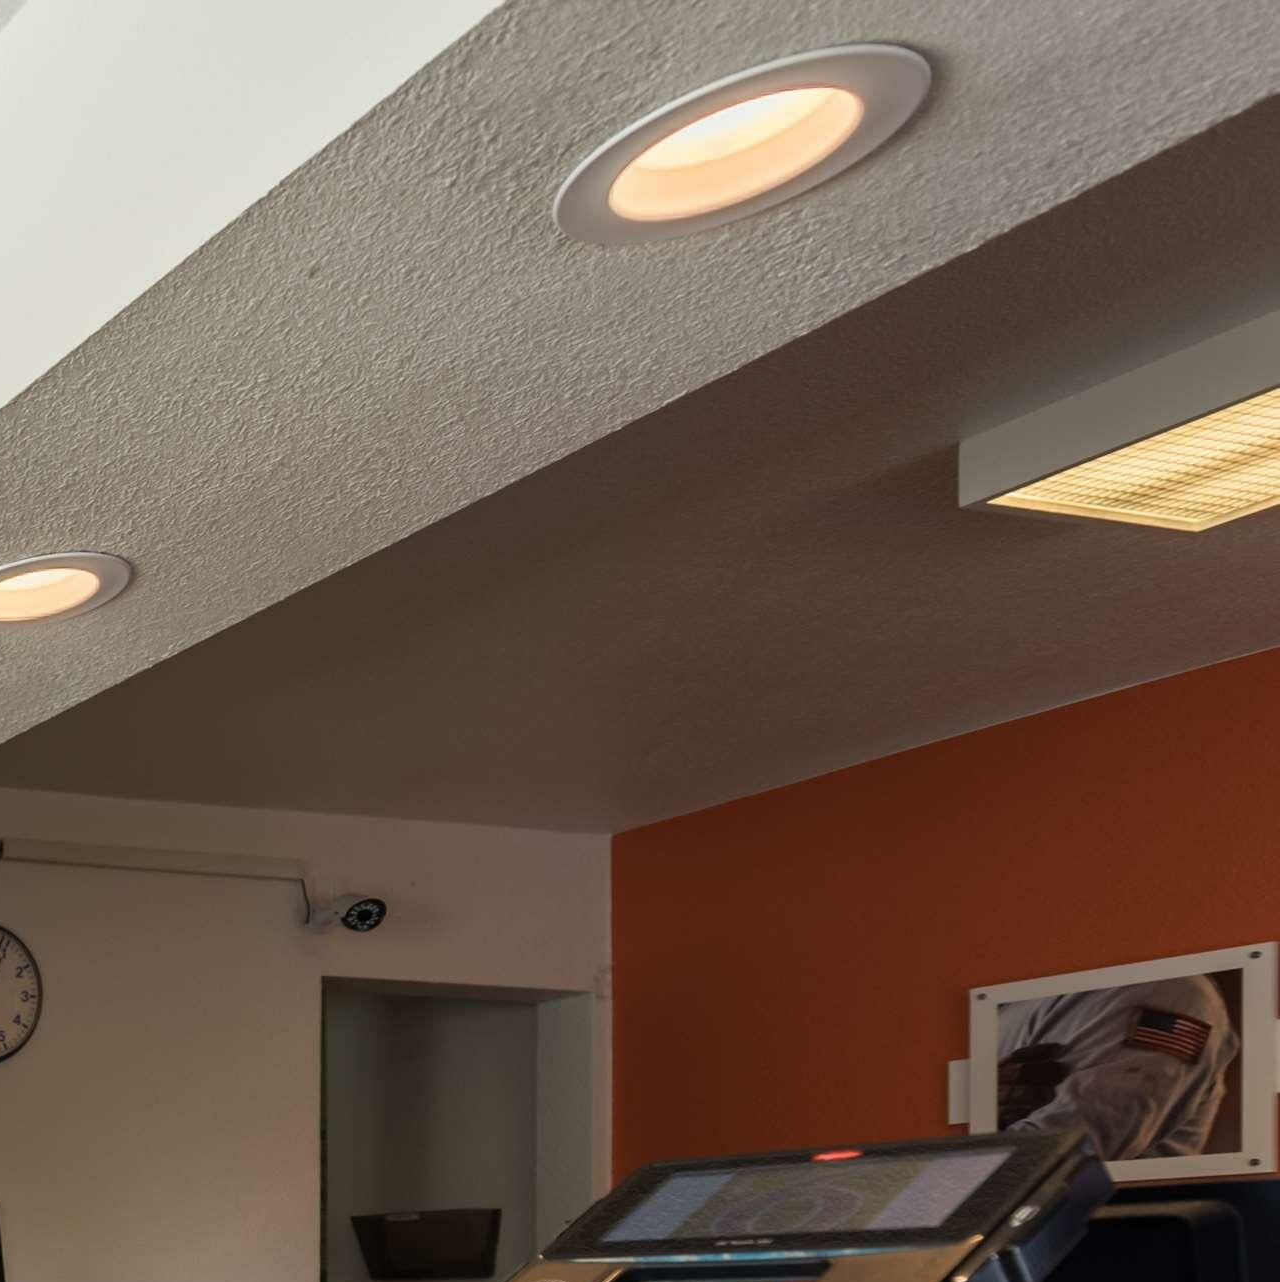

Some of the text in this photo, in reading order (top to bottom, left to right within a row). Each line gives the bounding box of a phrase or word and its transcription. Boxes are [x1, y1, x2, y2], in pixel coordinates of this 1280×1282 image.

[16, 966, 23, 978] 2
[21, 991, 29, 1002] 3
[12, 1015, 21, 1025] 4
